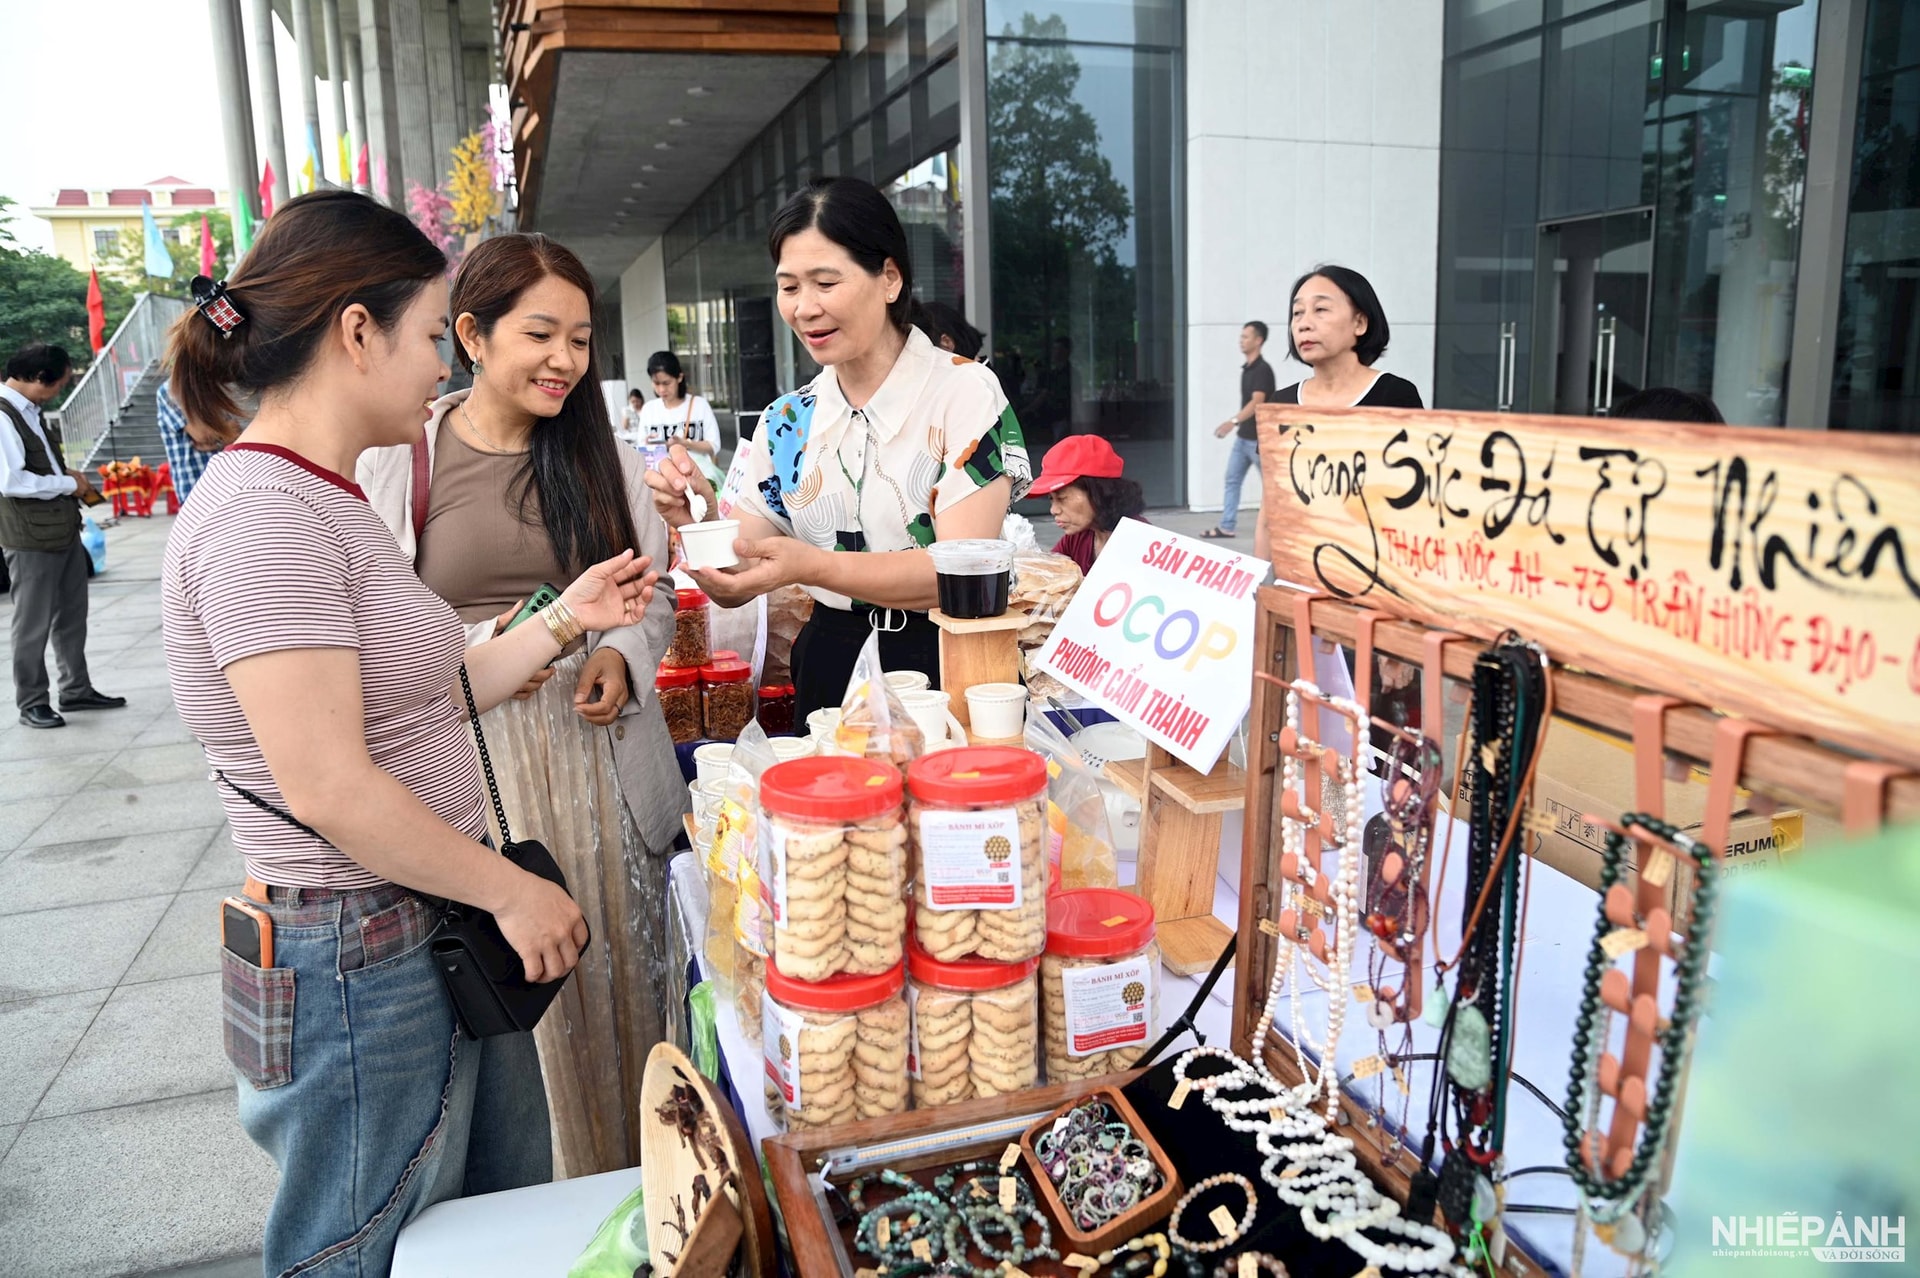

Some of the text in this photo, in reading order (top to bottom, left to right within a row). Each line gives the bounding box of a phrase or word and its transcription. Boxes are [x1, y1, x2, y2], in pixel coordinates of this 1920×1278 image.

[1278, 424, 1402, 599] Trang
[1480, 431, 1566, 545] Đá
[1695, 455, 1920, 601] Nhiên
[1142, 537, 1255, 599] SẢN PHẨM
[1381, 528, 1449, 580] THẠCH
[1457, 531, 1499, 591] MỘC
[1508, 550, 1544, 599] AH
[1572, 565, 1614, 613] 73
[1807, 615, 1877, 695] ĐẠO
[1093, 581, 1238, 673] OCOP
[1048, 637, 1111, 691] PHƯỜNG
[1139, 688, 1210, 751] THÀNH
[948, 822, 972, 831] BÁNH
[1091, 975, 1113, 985] BÁNH
[1114, 971, 1124, 980] MÌ
